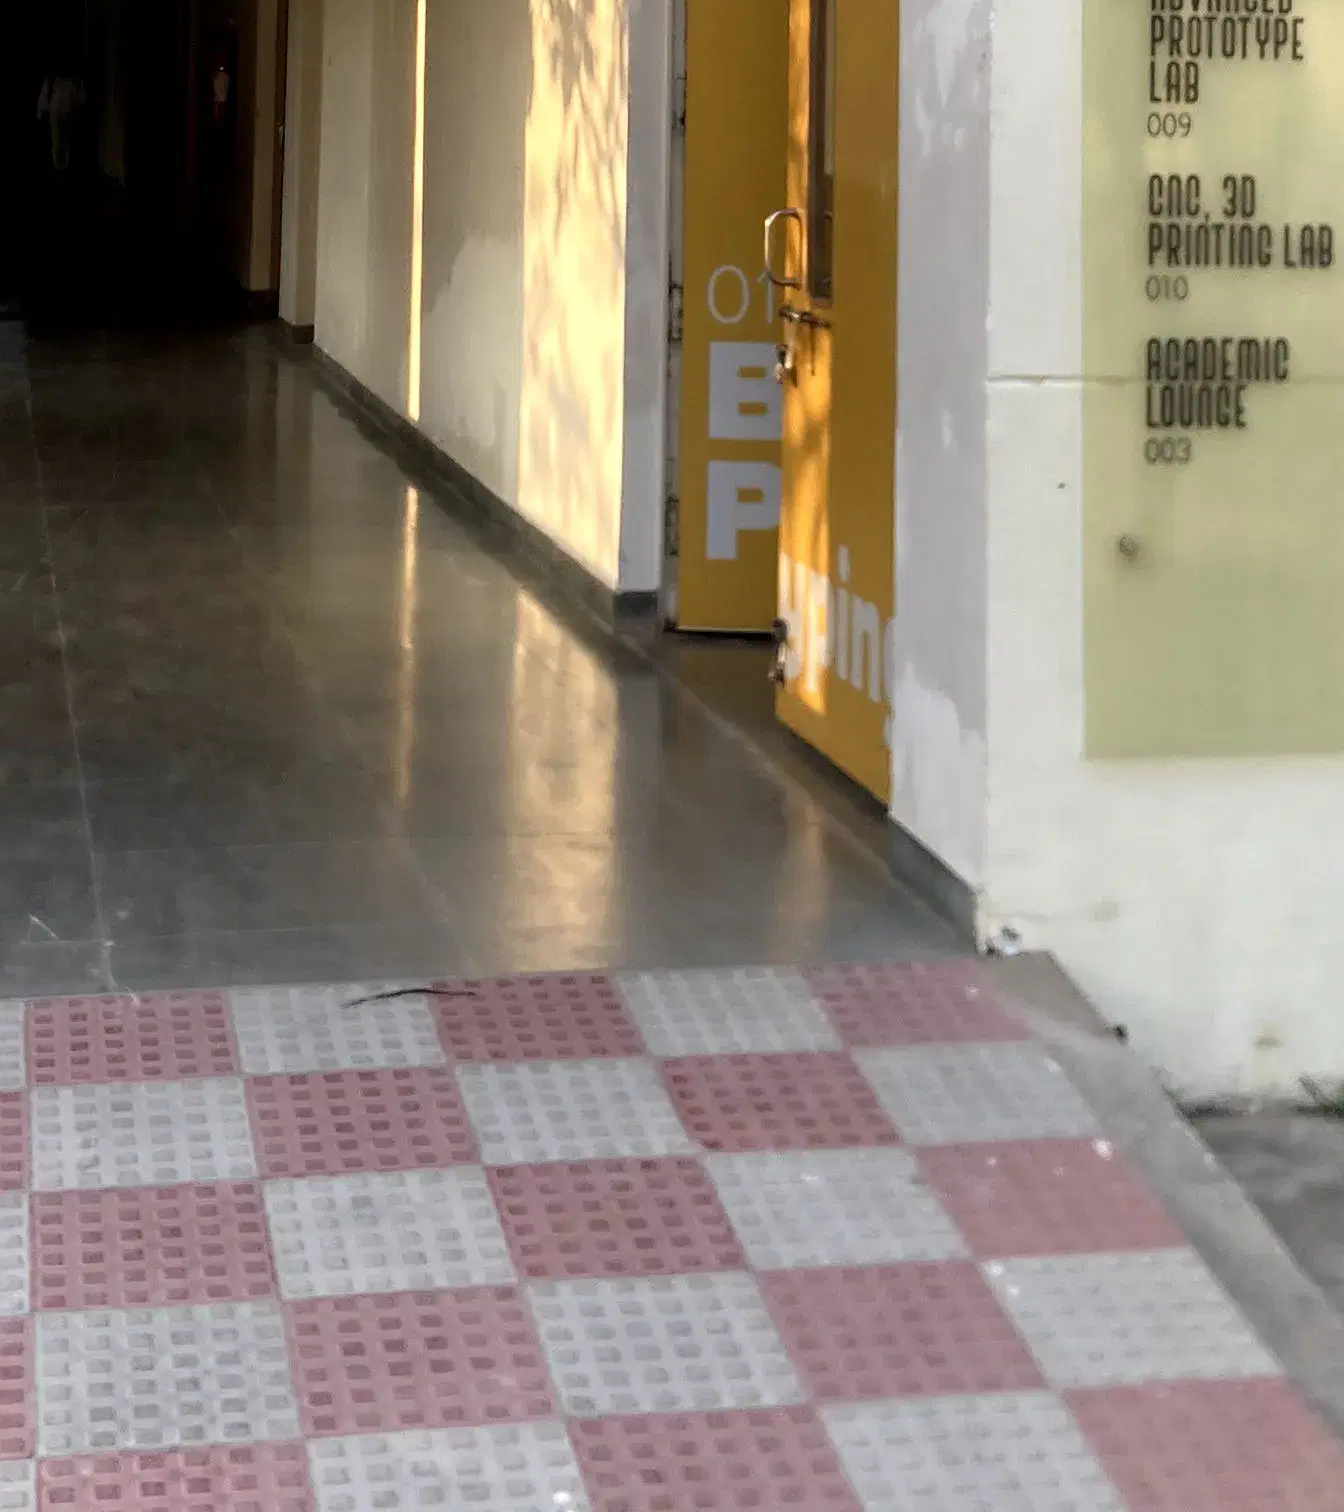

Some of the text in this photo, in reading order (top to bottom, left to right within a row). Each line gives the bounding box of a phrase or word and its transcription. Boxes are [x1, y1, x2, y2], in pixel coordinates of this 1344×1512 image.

[1150, 14, 1305, 61] PROTOTYPE
[1149, 60, 1200, 104] LAB
[1147, 112, 1192, 138] 009
[1147, 173, 1256, 223] CNC, 3D
[1147, 222, 1334, 269] PRINTING LAB
[1145, 274, 1189, 302] 010
[1145, 337, 1290, 383] ACADEMIC
[1145, 385, 1248, 429] LOUNGE
[1145, 437, 1193, 465] 003
